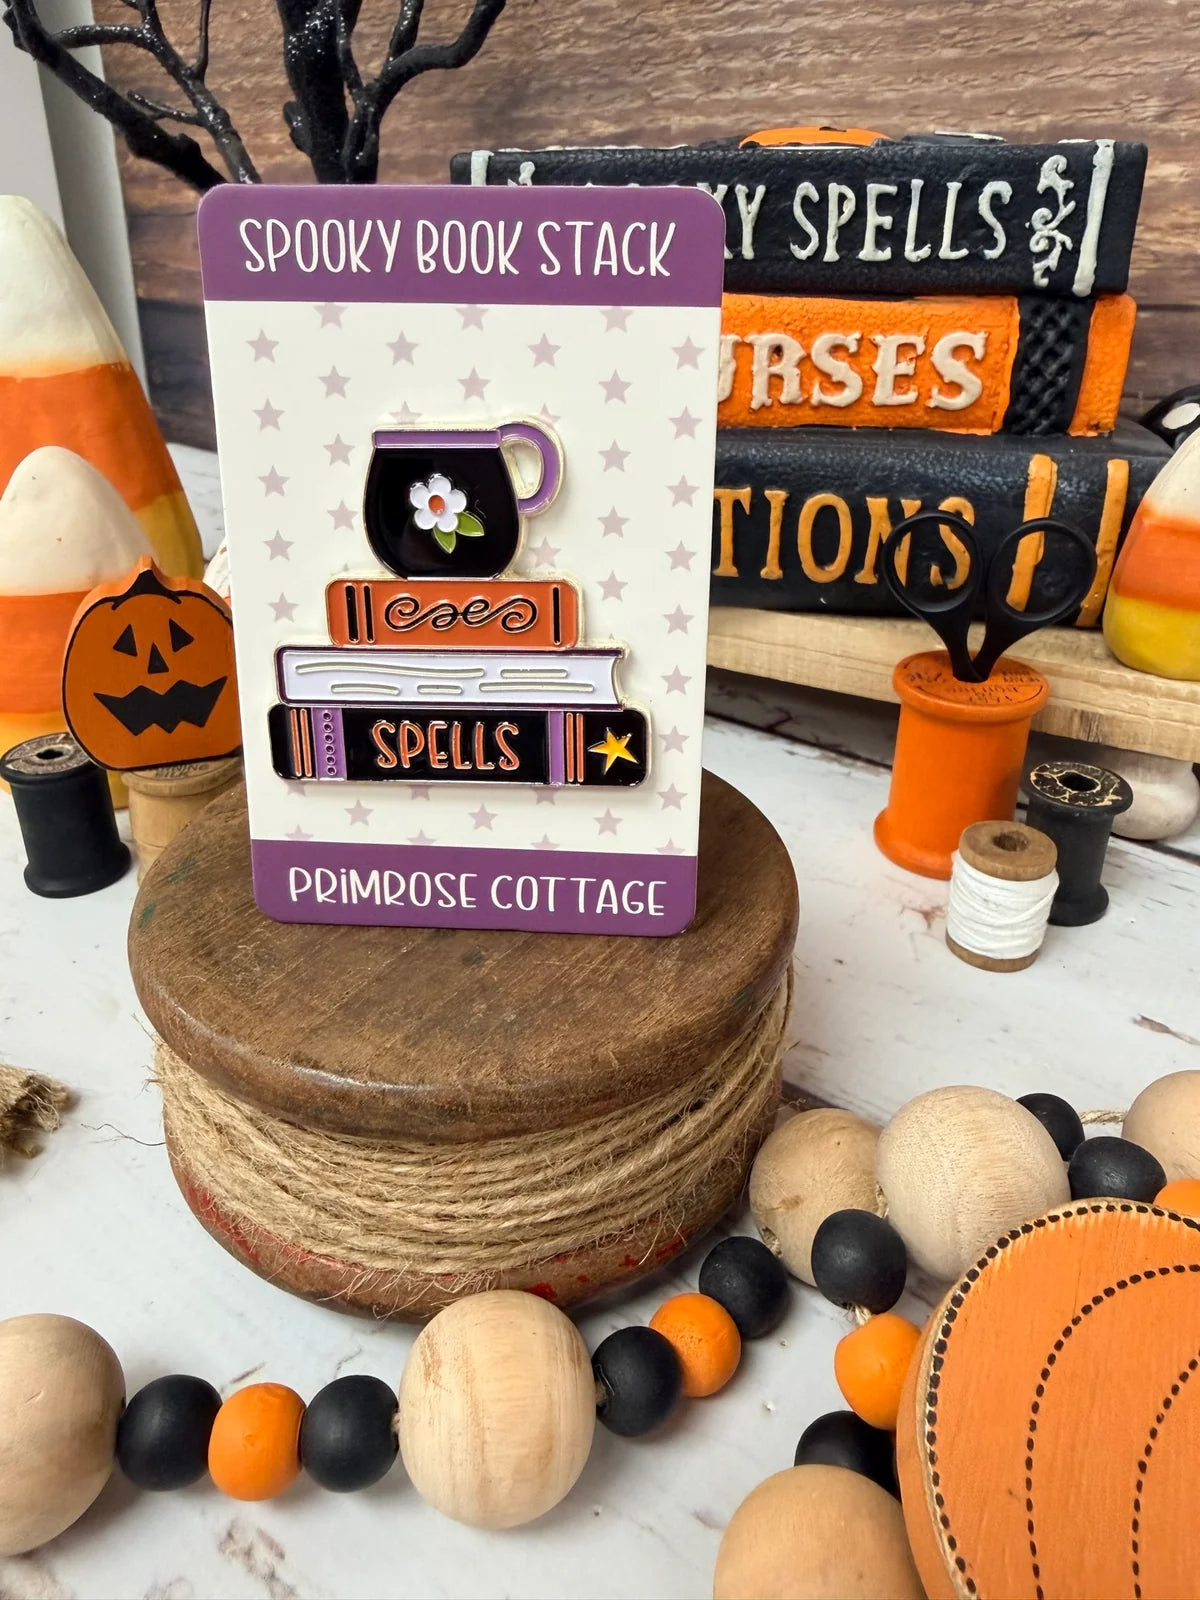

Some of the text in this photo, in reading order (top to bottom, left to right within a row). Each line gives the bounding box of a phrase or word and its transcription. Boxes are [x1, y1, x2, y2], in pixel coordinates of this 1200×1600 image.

[790, 178, 1013, 261] SPELLS
[239, 218, 677, 277] SPOOKY BOOK STACK
[371, 719, 521, 771] SPELLS
[491, 875, 667, 916] COTTAGE
